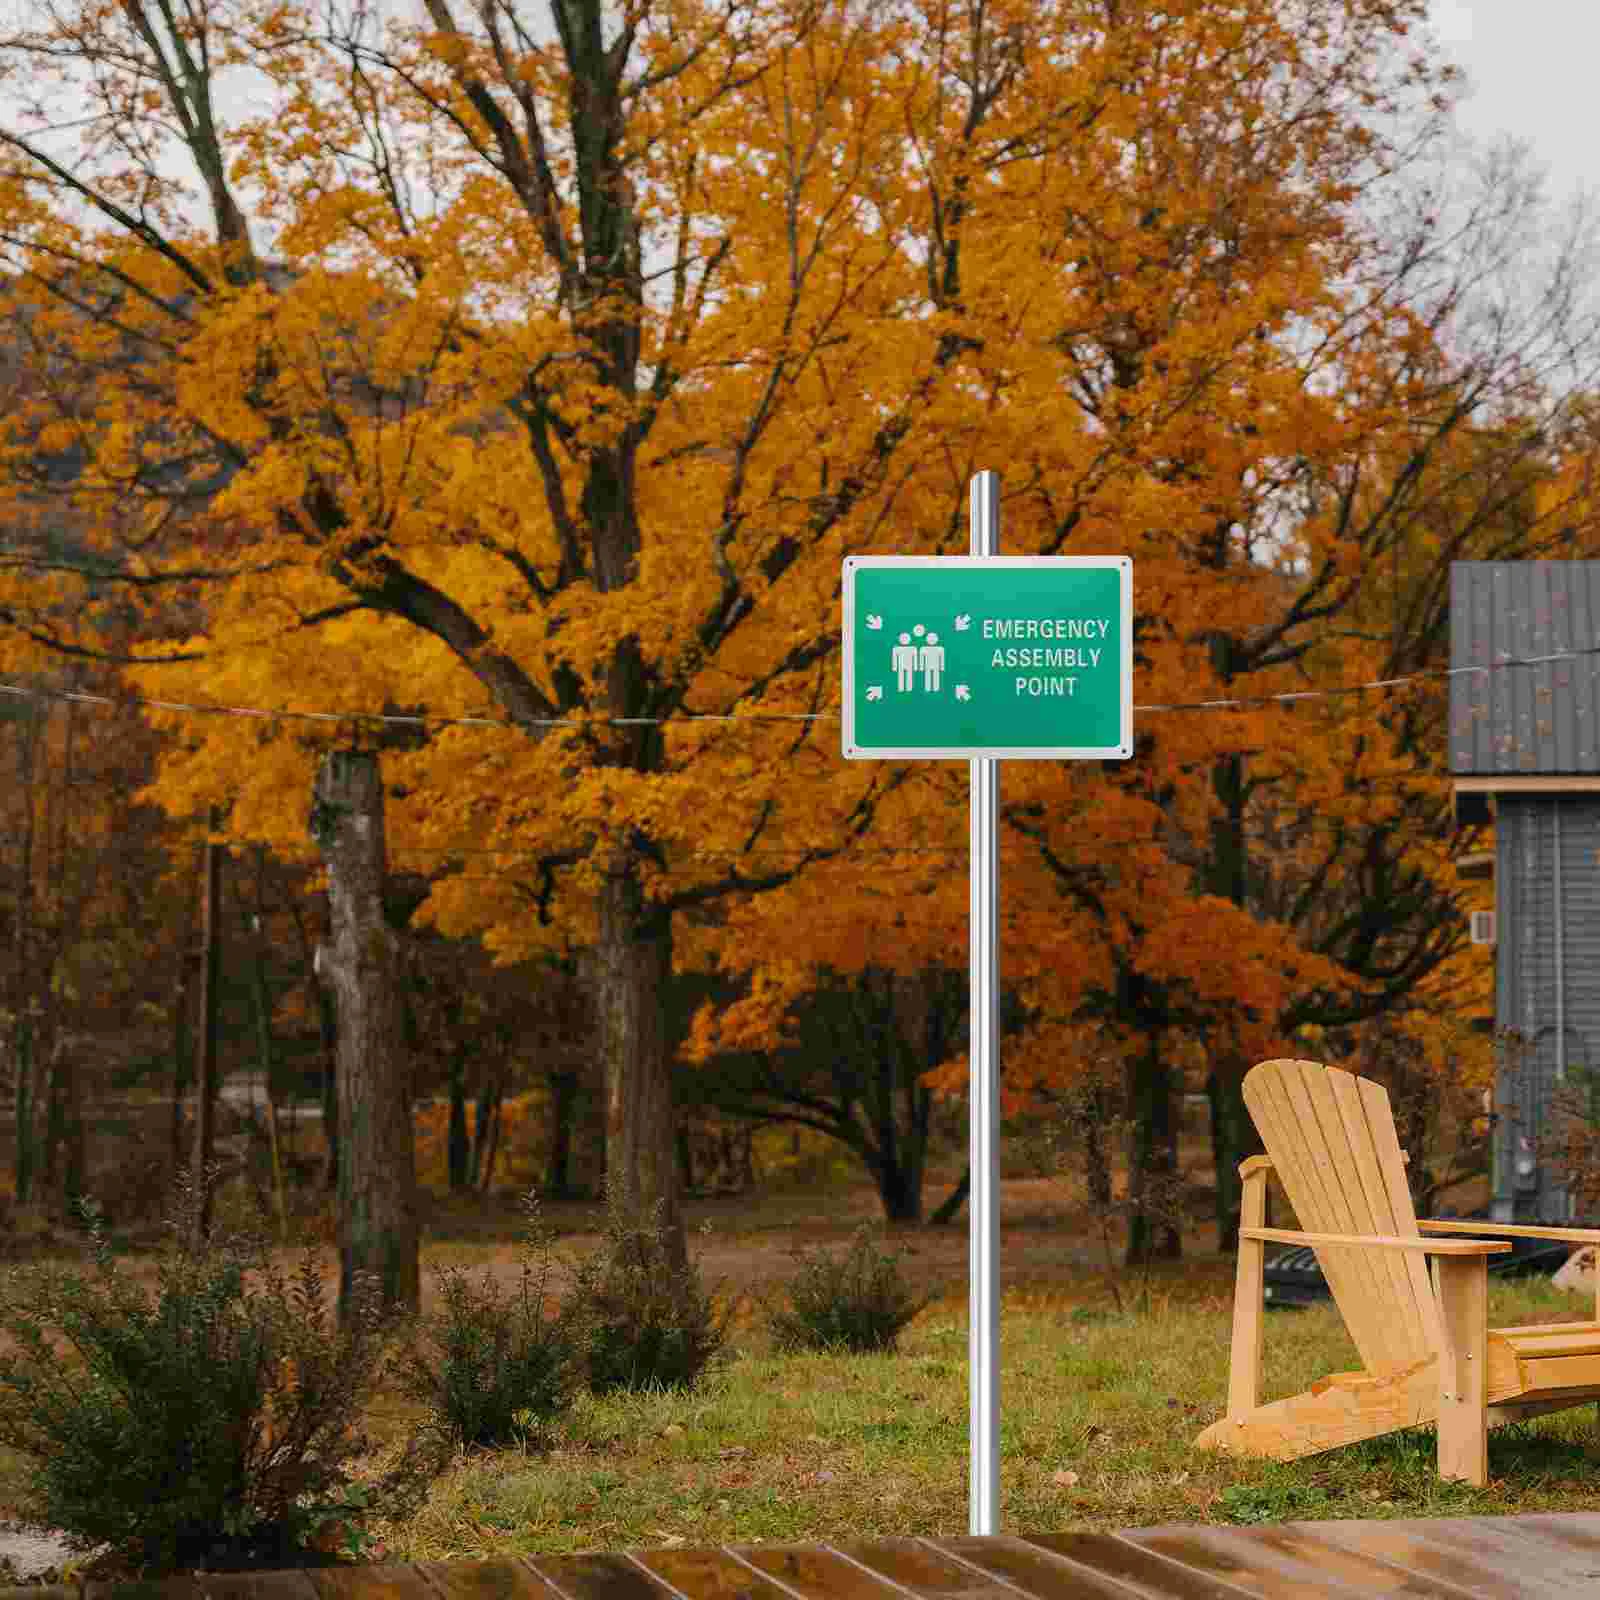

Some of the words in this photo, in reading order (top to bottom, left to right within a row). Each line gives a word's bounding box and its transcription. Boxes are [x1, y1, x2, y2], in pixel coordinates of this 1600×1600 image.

[983, 619, 1110, 639] EMERGENCY
[992, 648, 1102, 668] ASSEMBLY
[1015, 677, 1077, 696] POINT
